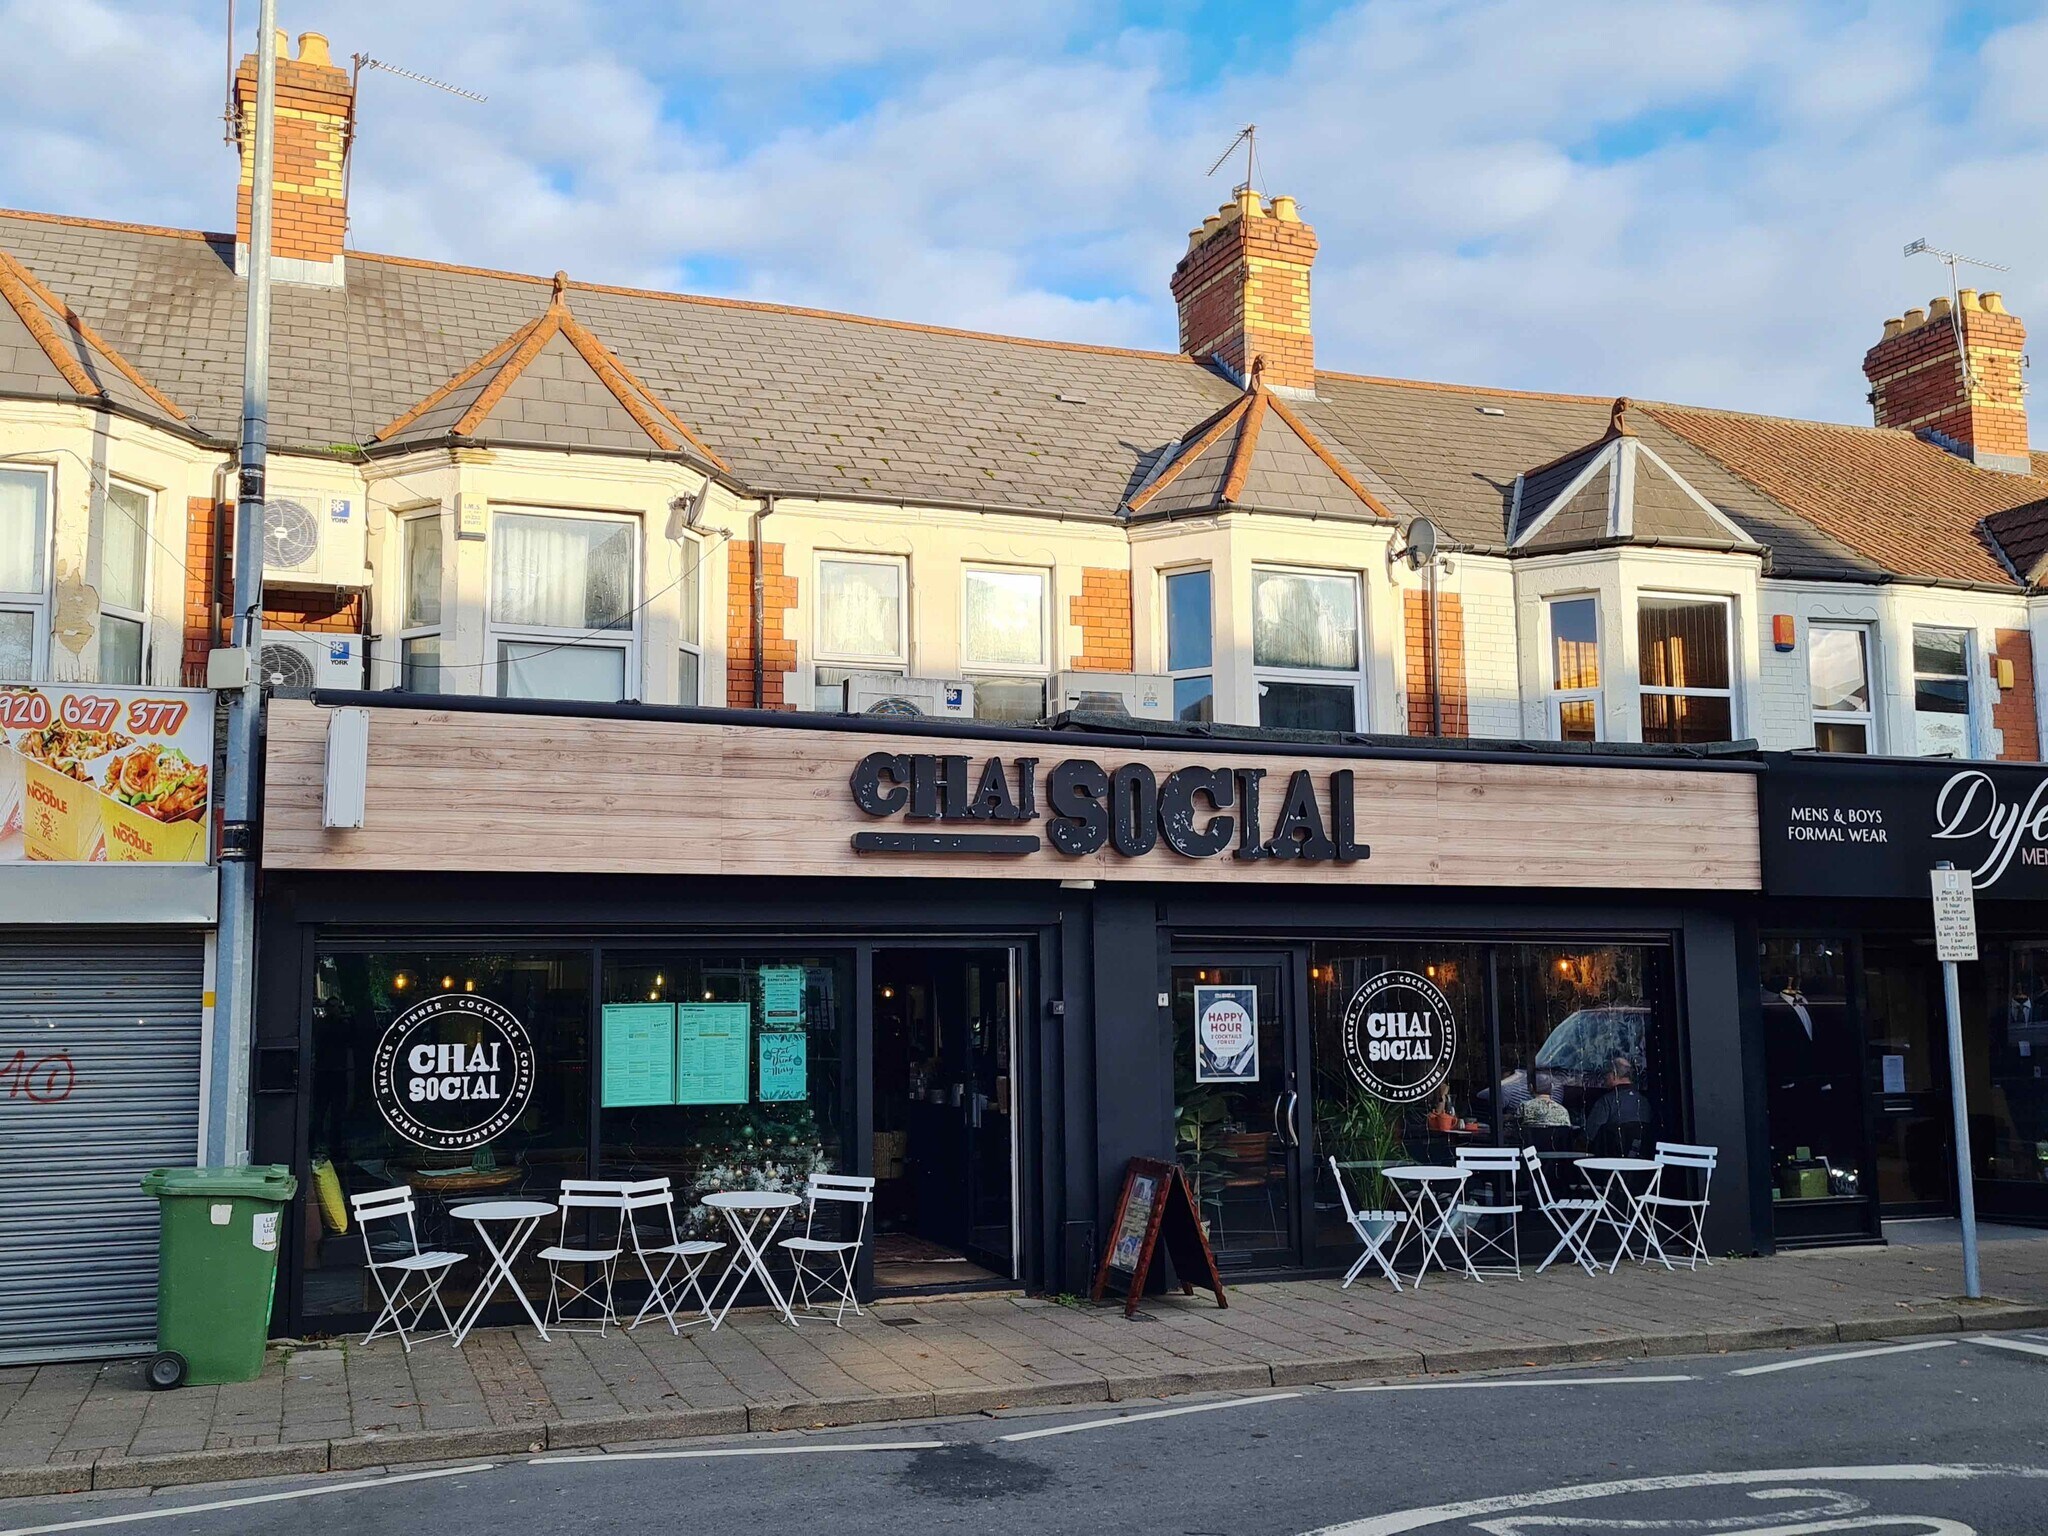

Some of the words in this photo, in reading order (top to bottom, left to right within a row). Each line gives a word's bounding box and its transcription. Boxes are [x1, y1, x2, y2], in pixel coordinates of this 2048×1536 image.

[64, 697, 115, 727] 627
[131, 702, 182, 729] 377
[27, 783, 67, 814] NOODLE
[849, 751, 1041, 822] CHAI
[1046, 758, 1371, 862] SOCIAL
[1791, 807, 1829, 821] MENS
[1833, 808, 1847, 825] &
[1848, 809, 1882, 823] BOYS
[113, 825, 152, 855] NOODLE
[1788, 826, 1845, 841] FORMAL
[1848, 828, 1887, 842] WEAR
[1358, 977, 1388, 1003] DINNER
[1399, 976, 1443, 1008] COCKTAILS
[398, 1002, 442, 1032] DINNER
[458, 1000, 519, 1038] COCKTAILS
[1208, 1012, 1243, 1021] HAPPY
[1211, 1023, 1242, 1032] HOUR
[1366, 1012, 1432, 1038] CHAI
[1347, 1013, 1356, 1054] SNACKS
[1444, 1020, 1452, 1060] COFFEE
[408, 1043, 500, 1074] CHAI
[1368, 1039, 1433, 1061] SOCIAL
[380, 1044, 393, 1094] SNACKS
[516, 1052, 529, 1099] COFFEE
[1356, 1066, 1382, 1092] LUNCH
[1392, 1071, 1441, 1097] BREAKFAST
[409, 1075, 500, 1101] SOCIAL
[390, 1108, 425, 1138] LUNCH
[439, 1112, 510, 1144] BREAKFAST
